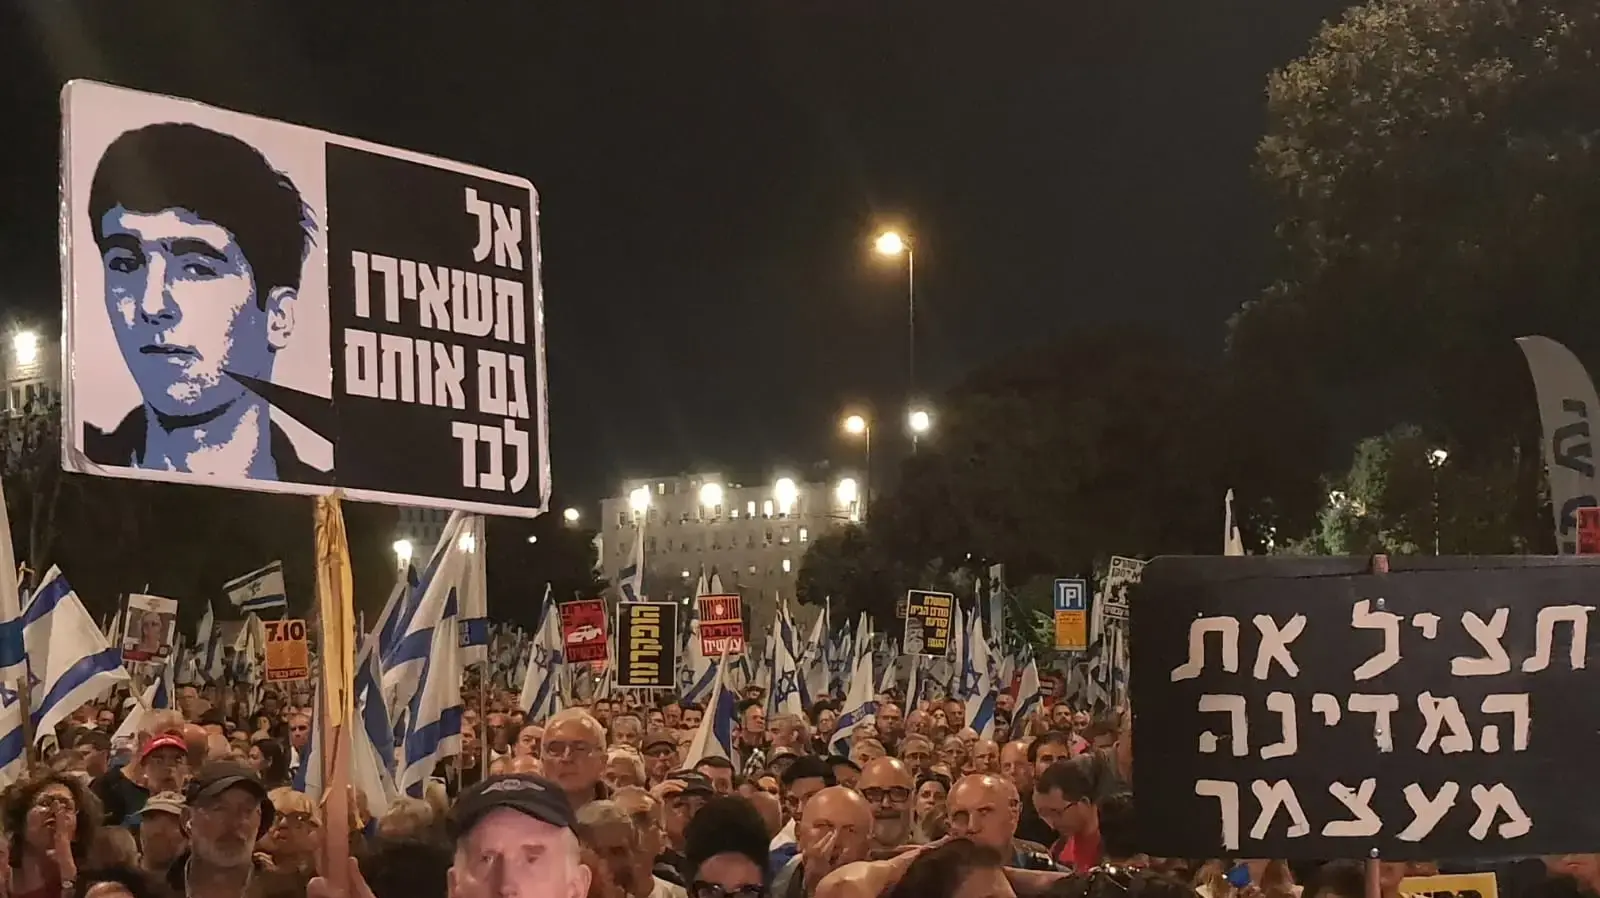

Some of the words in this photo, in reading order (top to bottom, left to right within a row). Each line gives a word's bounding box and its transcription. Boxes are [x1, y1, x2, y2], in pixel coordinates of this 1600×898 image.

[465, 187, 523, 271] אל
[351, 251, 526, 345] תשאירו
[344, 328, 466, 411] אותם
[477, 349, 530, 419] גם
[451, 419, 530, 494] לבד
[265, 621, 304, 642] 7.10
[1170, 612, 1307, 682] את
[1352, 599, 1597, 682] תציל
[1198, 690, 1532, 760] המדינה
[1195, 777, 1533, 852] מעצמך
